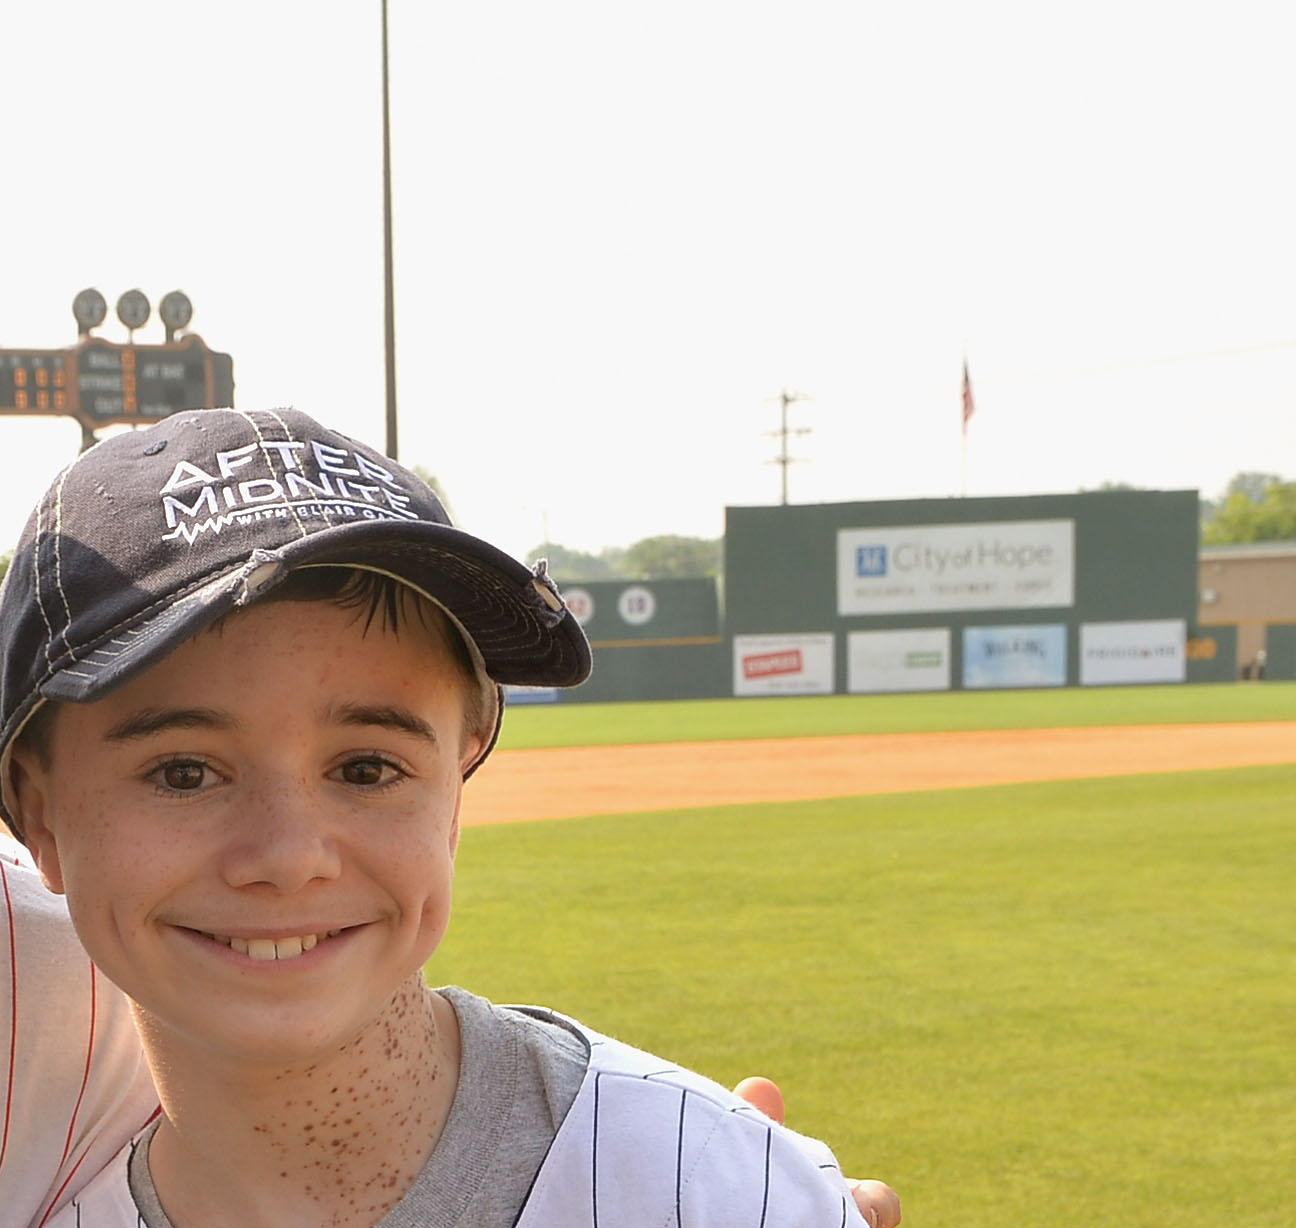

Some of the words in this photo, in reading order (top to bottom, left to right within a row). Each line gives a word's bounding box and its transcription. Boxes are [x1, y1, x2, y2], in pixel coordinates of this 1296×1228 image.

[159, 440, 407, 494] AFTER
[162, 473, 419, 528] MIDNITE
[236, 508, 287, 525] WITH
[297, 505, 355, 517] BLAIR
